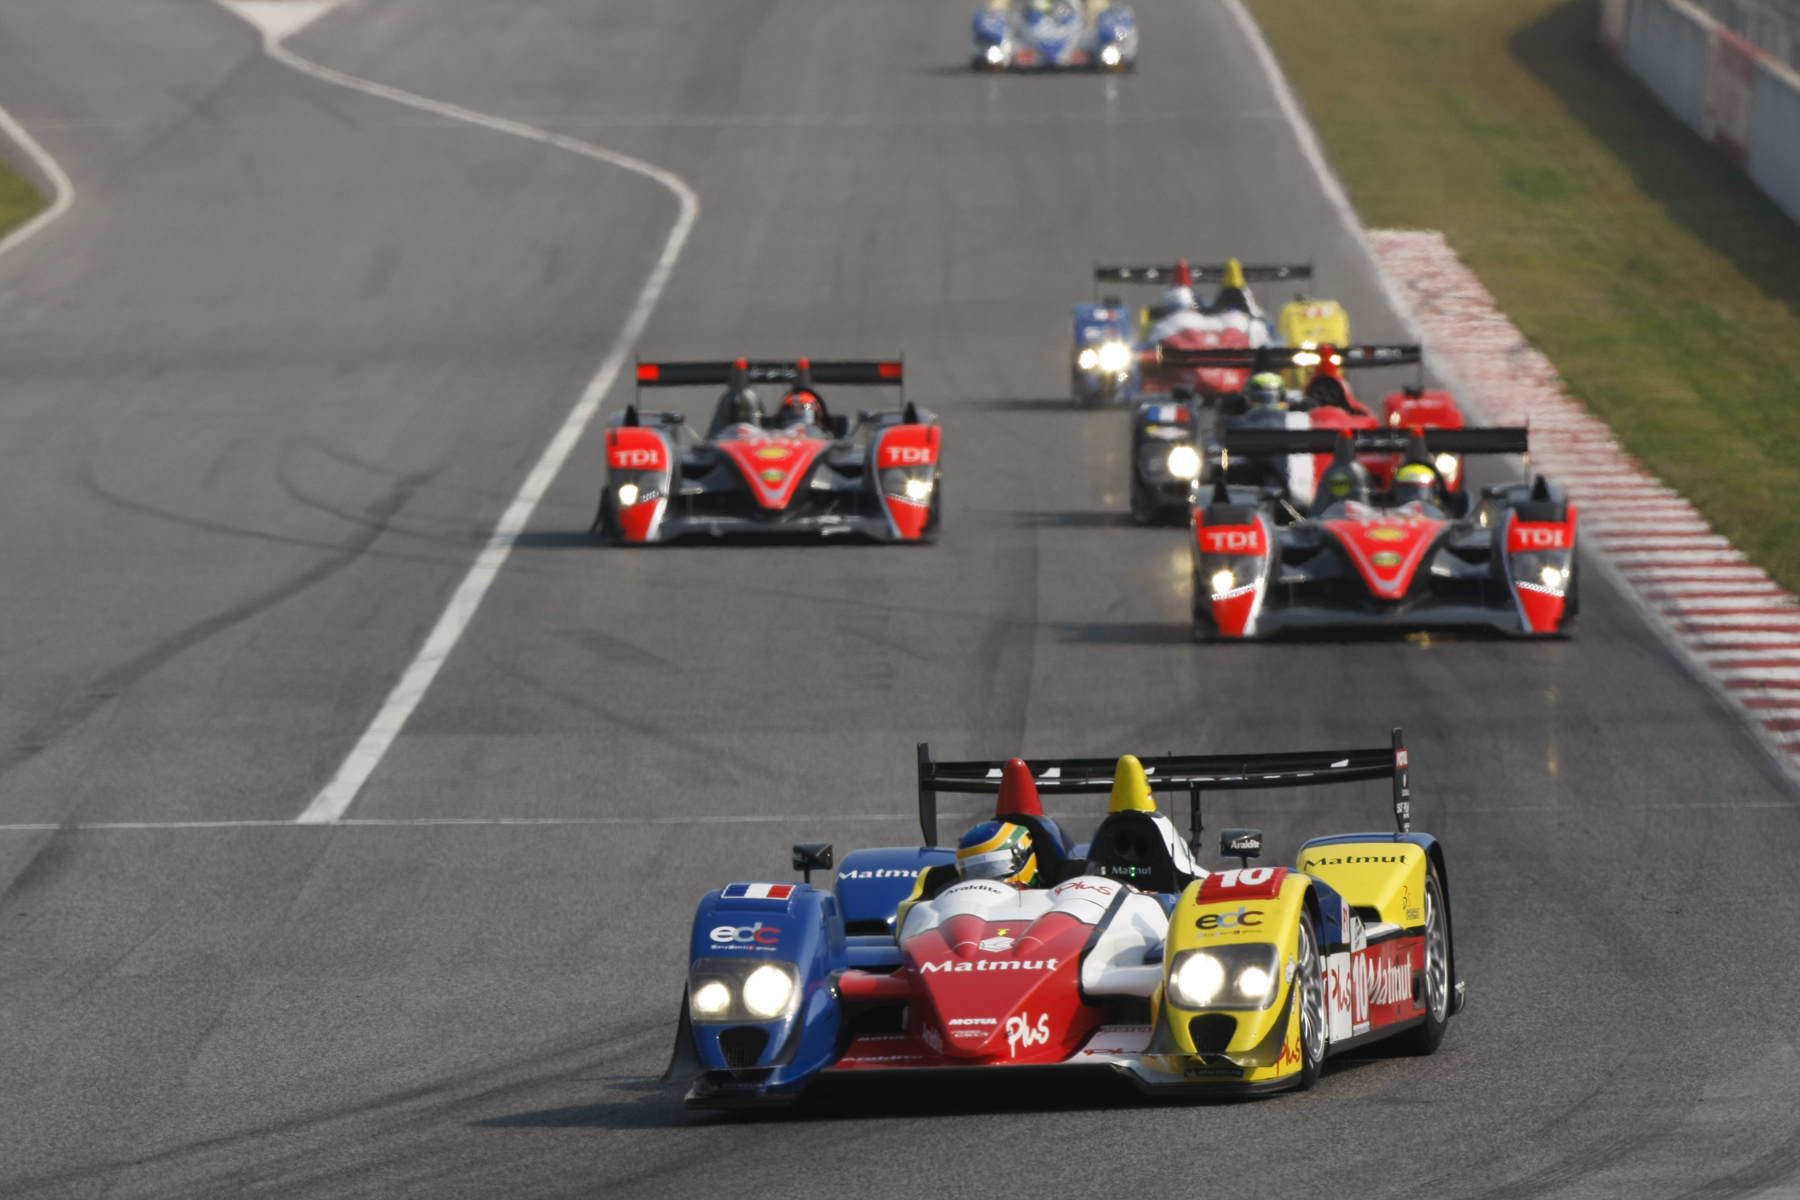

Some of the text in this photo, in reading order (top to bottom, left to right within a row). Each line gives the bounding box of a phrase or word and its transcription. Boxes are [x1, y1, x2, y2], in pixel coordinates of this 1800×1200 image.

[613, 449, 659, 466] TDI
[886, 446, 930, 463] TDI
[1206, 531, 1258, 550] TDI
[1514, 527, 1564, 547] TDI
[1303, 854, 1408, 872] Matmut
[835, 868, 920, 883] Matm
[1214, 867, 1276, 888] 10
[944, 884, 1003, 897] Araldite
[1195, 906, 1265, 930] edc
[709, 922, 782, 944] edc
[920, 958, 1059, 974] Matmut
[1353, 952, 1369, 1021] 10
[1368, 951, 1412, 1005] Matmut
